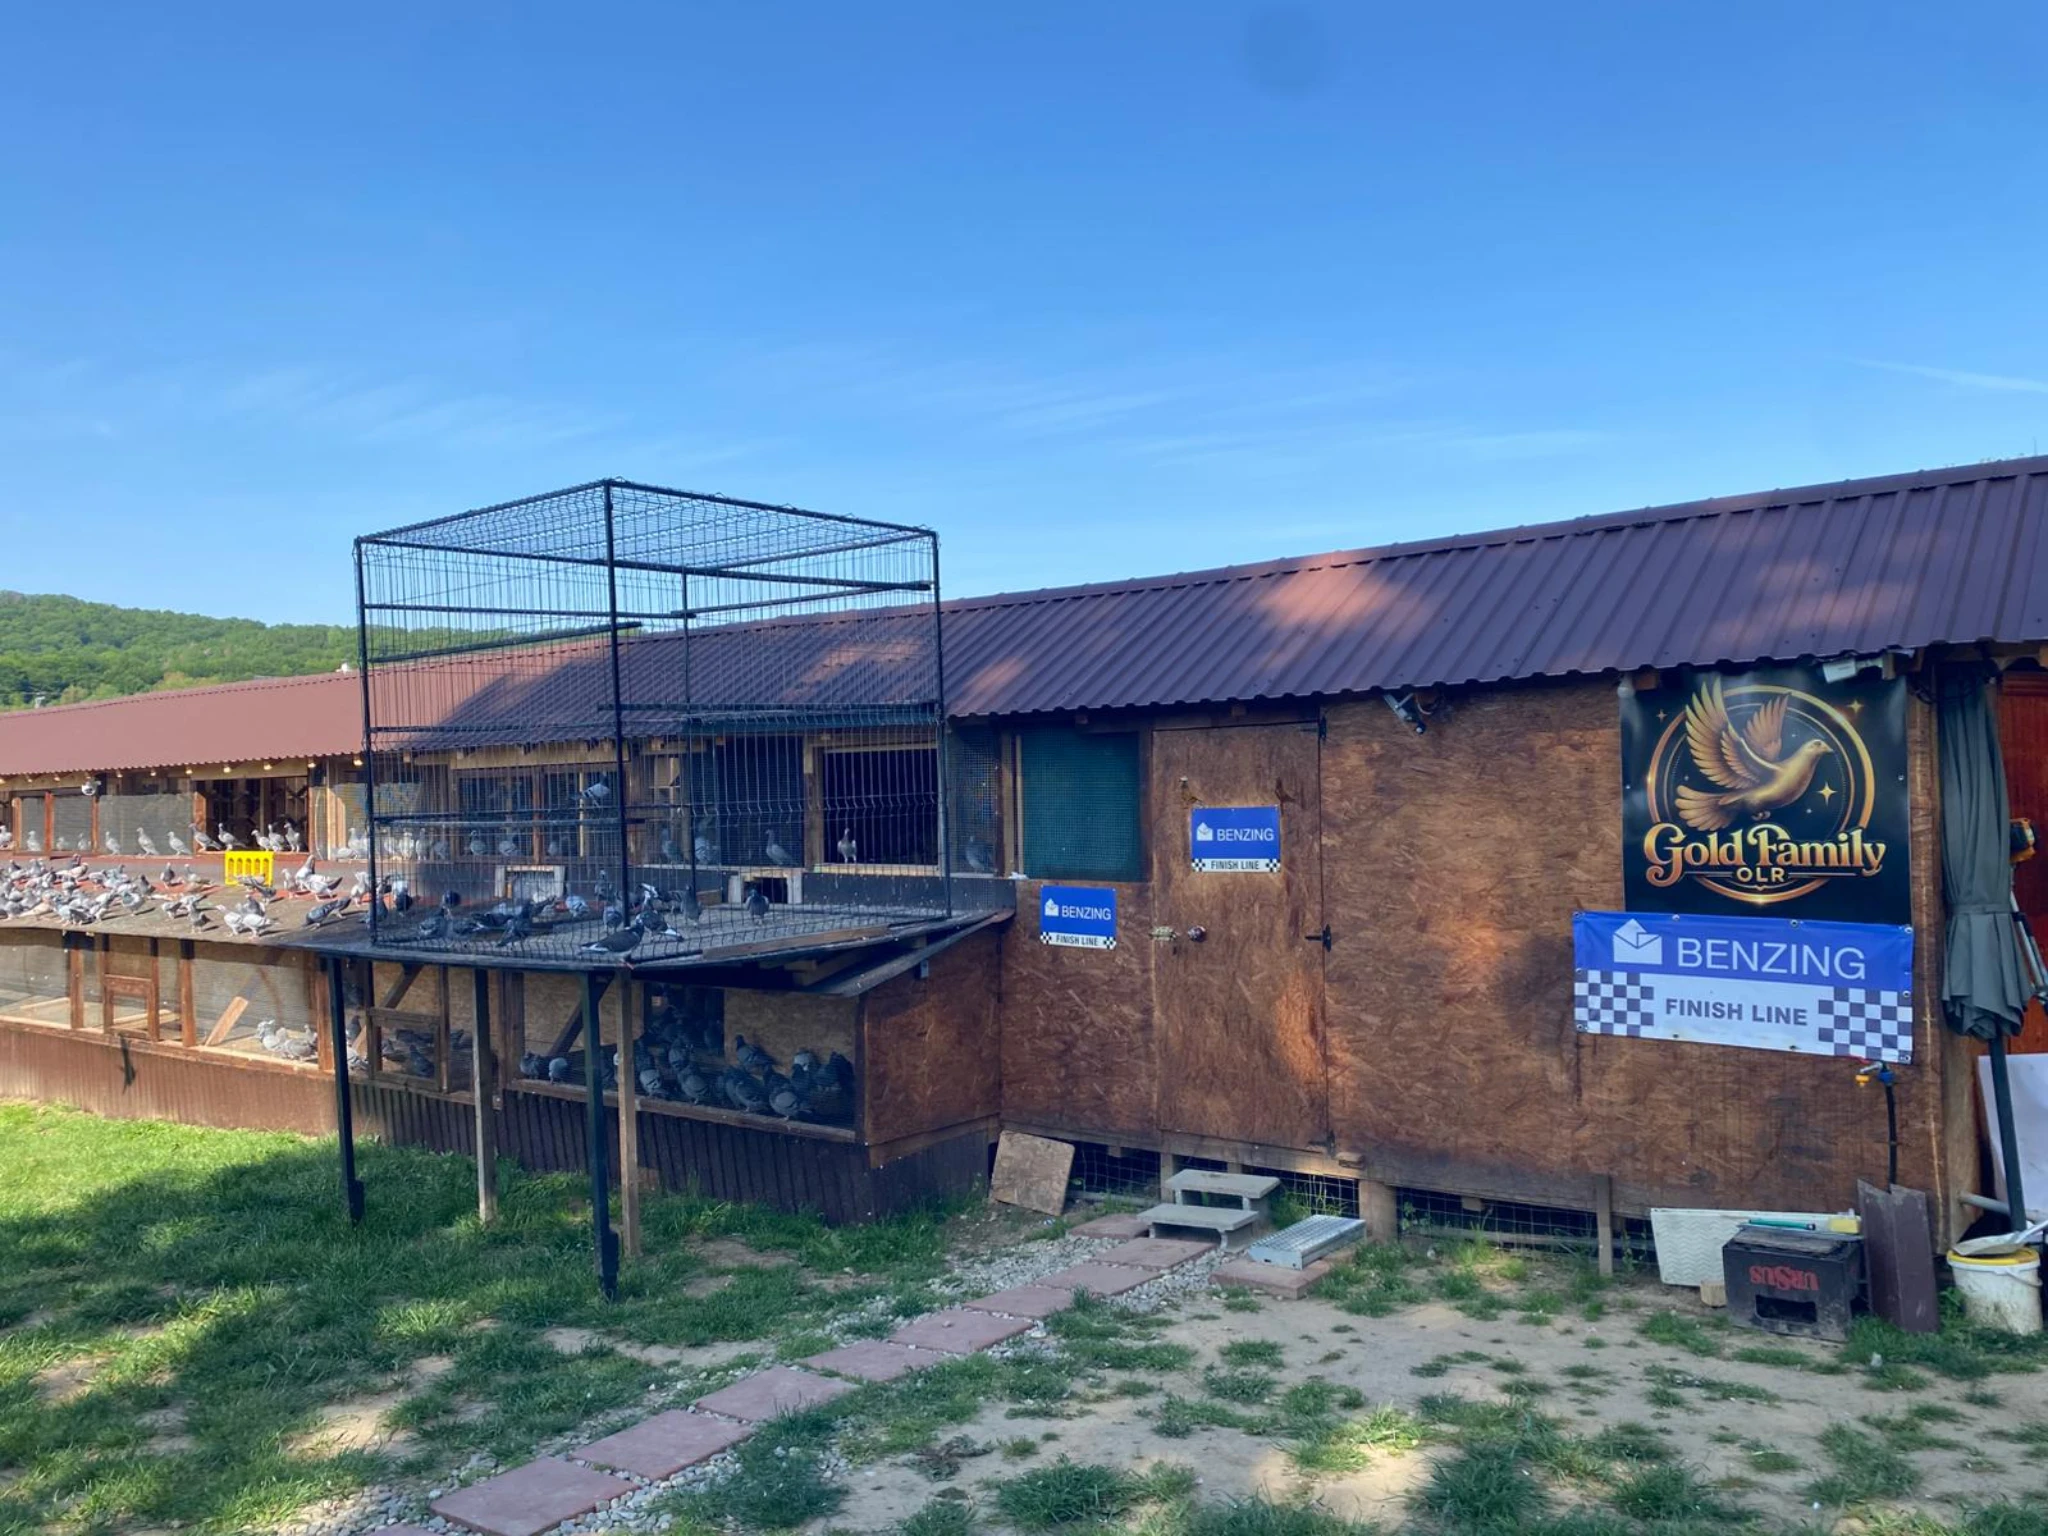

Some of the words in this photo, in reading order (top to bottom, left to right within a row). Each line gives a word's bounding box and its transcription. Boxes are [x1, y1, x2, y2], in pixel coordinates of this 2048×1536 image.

[1216, 826, 1275, 842] BENZING
[1643, 823, 1745, 887] Gold
[1747, 823, 1887, 877] Family
[1211, 859, 1237, 870] FINISH
[1241, 859, 1260, 870] LINE
[1736, 865, 1786, 884] OLR
[1061, 905, 1112, 921] BENZING
[1056, 934, 1080, 945] FINISH
[1081, 936, 1098, 946] LINE
[1677, 937, 1867, 980] BENZING
[1665, 998, 1743, 1020] FINISH
[1752, 1004, 1808, 1026] LINE
